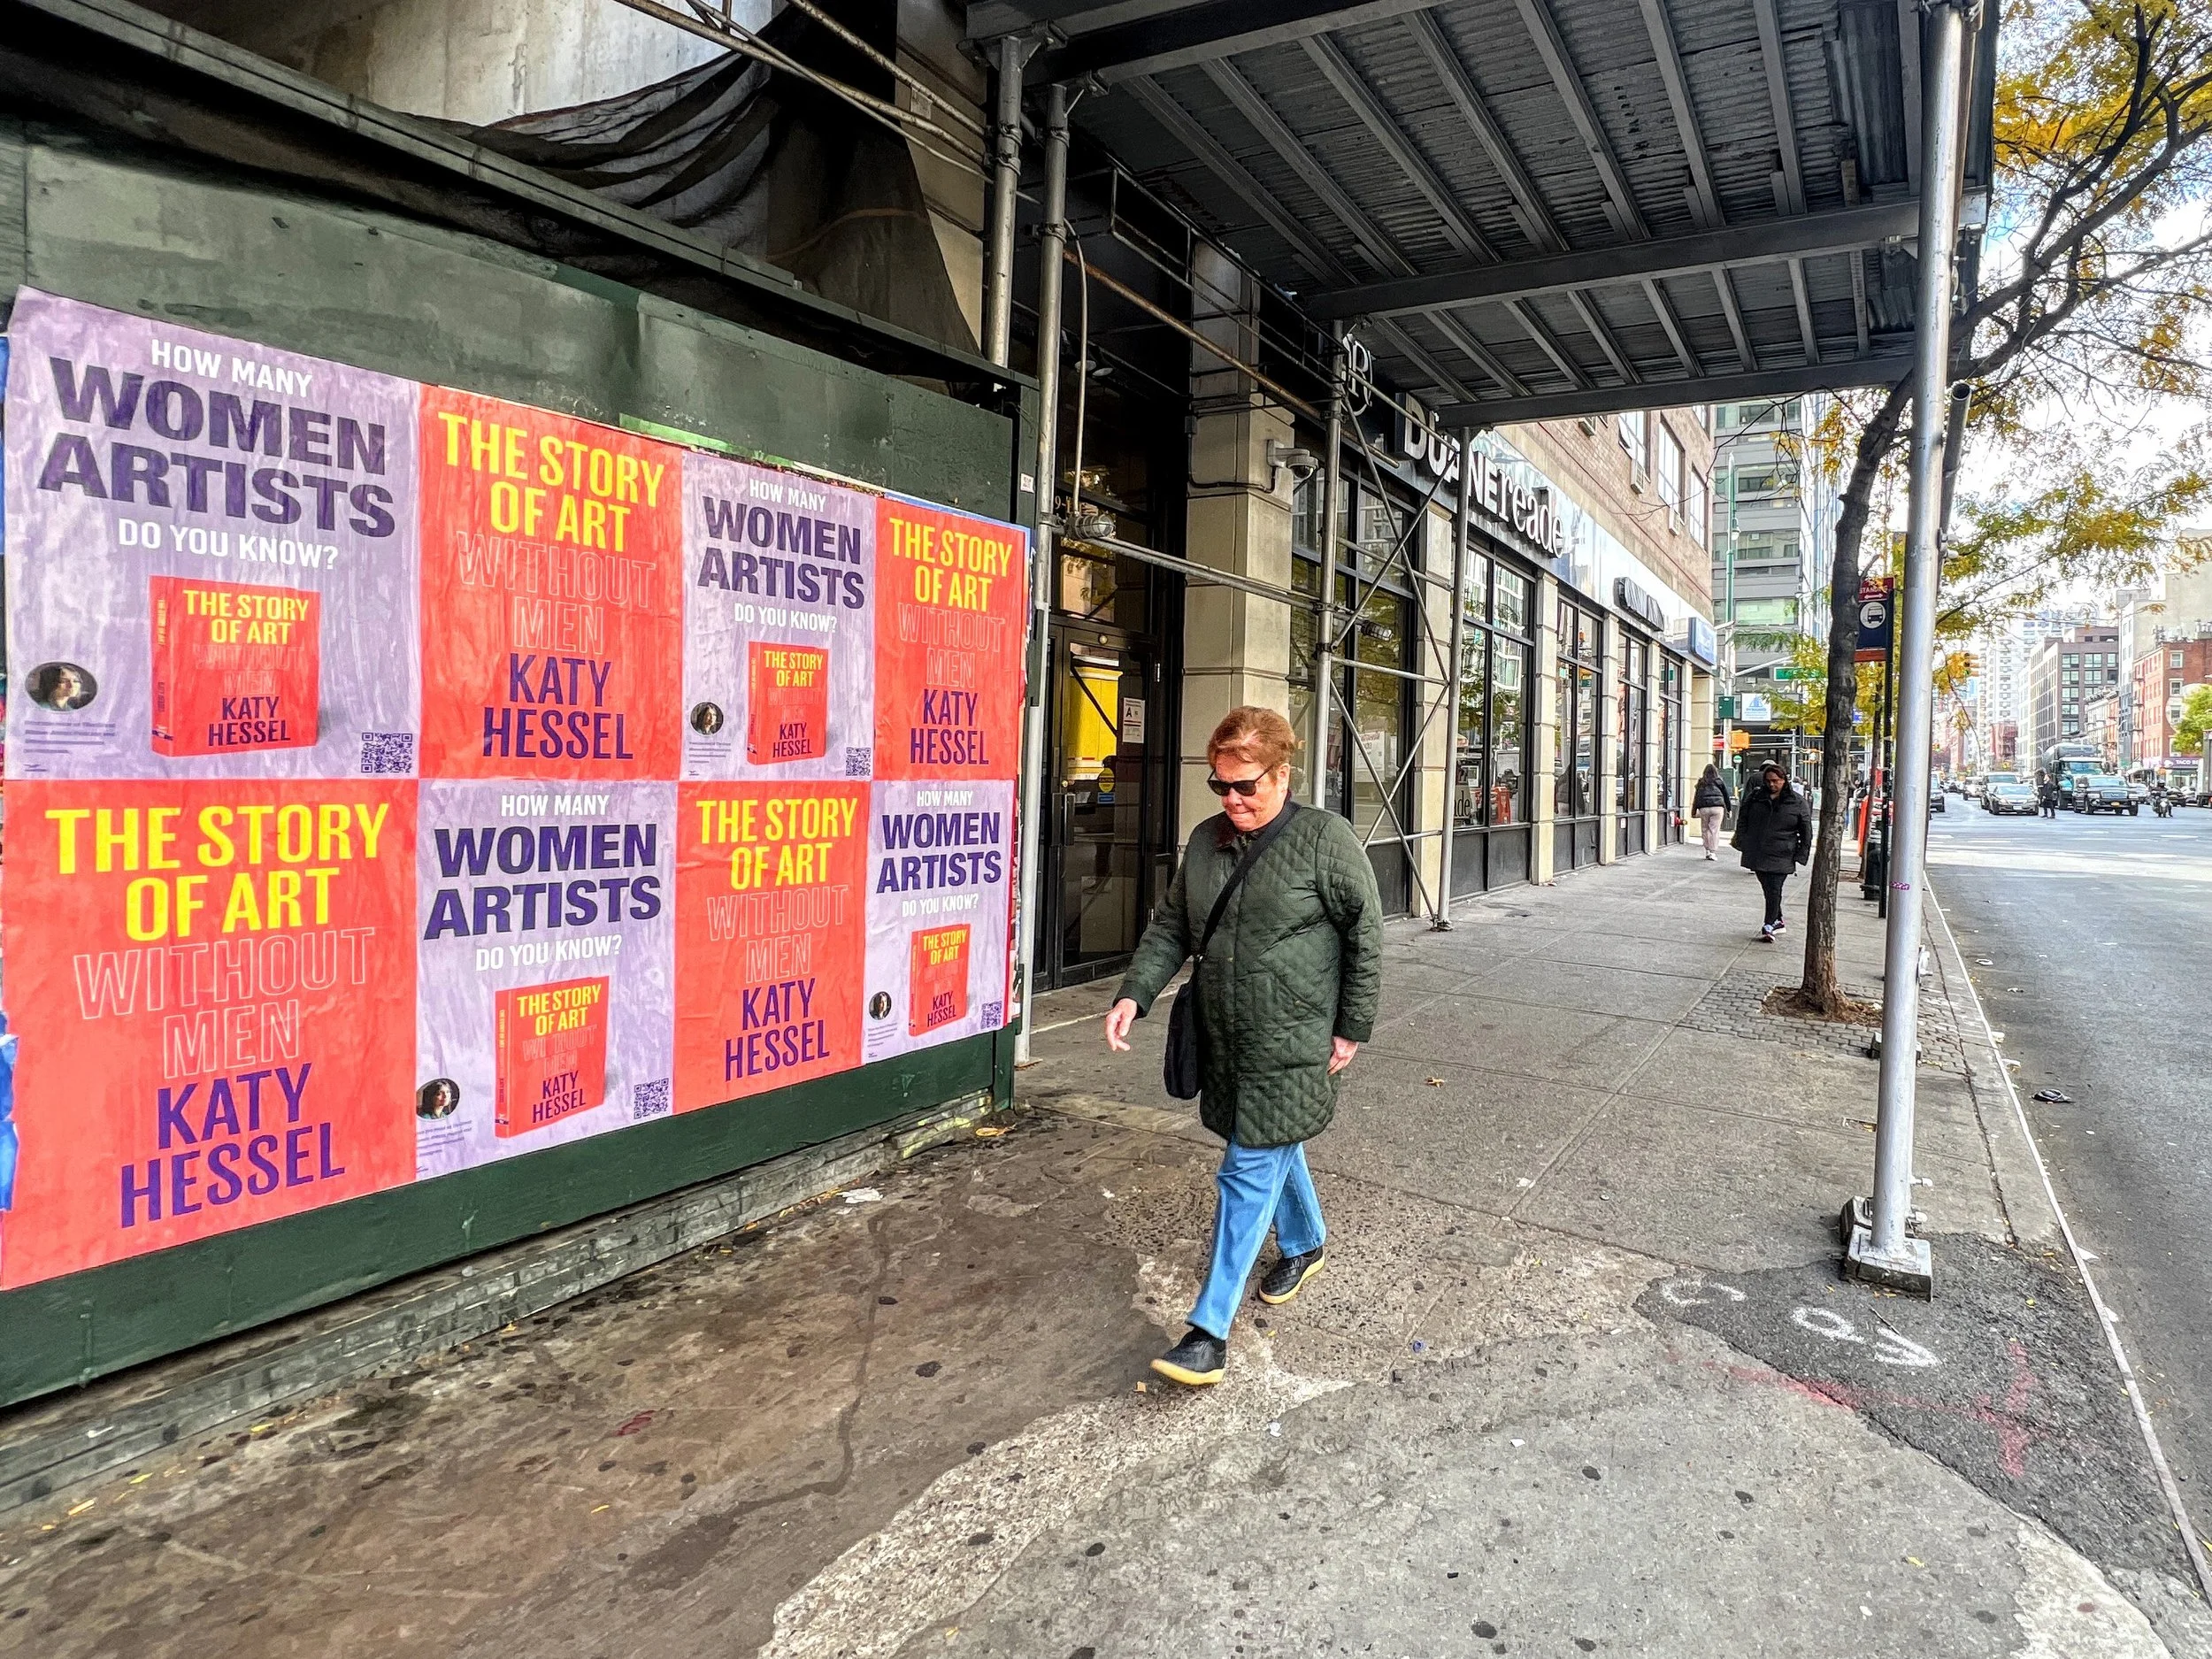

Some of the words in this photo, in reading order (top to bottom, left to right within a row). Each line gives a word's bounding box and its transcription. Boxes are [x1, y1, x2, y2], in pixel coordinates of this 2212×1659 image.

[150, 339, 221, 379] HOW
[231, 361, 312, 398] MANY
[50, 357, 386, 476] WOMEN
[438, 411, 528, 480] THE
[539, 434, 665, 508] STORY
[37, 432, 396, 538] ARTISTS
[749, 479, 783, 503] HOW
[787, 488, 826, 512] MANY
[489, 480, 547, 536] OF
[556, 493, 631, 552] ART
[702, 495, 861, 565] WOMEN
[119, 519, 161, 550] DO
[171, 525, 228, 557] YOU
[239, 535, 339, 570] KNOW?
[889, 518, 935, 564] THE
[940, 530, 1013, 578] STORY
[456, 530, 657, 610] WITHOUT
[697, 546, 865, 610] ARTISTS
[915, 565, 944, 604] OF
[948, 572, 992, 613] ART
[183, 589, 233, 618] THE
[237, 595, 308, 621] STORY
[513, 595, 604, 656] MEN
[734, 603, 754, 624] DO
[758, 606, 787, 628] YOU
[790, 610, 838, 634] KNOW?
[897, 602, 1006, 653] WITHOUT
[211, 618, 242, 643] OF
[247, 621, 292, 645] ART
[509, 652, 612, 707] KATY
[764, 650, 787, 669] THE
[789, 652, 823, 671] STORY
[776, 670, 791, 687] OF
[792, 671, 814, 687] ART
[926, 647, 976, 688] MEN
[222, 696, 280, 720] KATY
[923, 688, 979, 726] KATY
[208, 720, 290, 747] HESSEL
[482, 706, 634, 760] HESSEL
[772, 739, 812, 758] HESSEL
[780, 722, 807, 740] KATY
[910, 727, 990, 765] HESSEL
[501, 795, 549, 818] HOW
[554, 795, 610, 816] MANY
[695, 799, 757, 844] THE
[765, 797, 858, 842] STORY
[916, 791, 941, 807] HOW
[943, 790, 973, 807] MANY
[44, 806, 181, 875] THE
[196, 803, 388, 866] STORY
[434, 823, 657, 878] WOMEN
[882, 811, 1001, 850] WOMEN
[730, 846, 771, 891] OF
[774, 841, 833, 888] ART
[876, 850, 1002, 894] ARTISTS
[125, 874, 209, 941] OF
[221, 867, 340, 933] ART
[423, 875, 662, 941] ARTISTS
[707, 885, 849, 941] WITHOUT
[902, 901, 918, 918] DO
[919, 897, 940, 915] YOU
[941, 893, 979, 912] KNOW?
[475, 947, 504, 972] DO
[509, 941, 549, 966] YOU
[555, 934, 623, 962] KNOW?
[745, 932, 812, 984] MEN
[923, 933, 940, 951] THE
[941, 929, 967, 948] STORY
[930, 949, 942, 965] OF
[942, 945, 960, 962] ART
[73, 926, 376, 1021] WITHOUT
[517, 993, 550, 1018] THE
[552, 984, 602, 1011] STORY
[535, 1013, 555, 1036] OF
[557, 1007, 588, 1032] ART
[741, 977, 816, 1031] KATY
[927, 1004, 956, 1027] HESSEL
[933, 991, 953, 1010] KATY
[163, 999, 300, 1080] MEN
[725, 1019, 830, 1082] HESSEL
[157, 1063, 312, 1150] KATY
[533, 1088, 586, 1123] HESSEL
[542, 1071, 579, 1099] KATY
[120, 1122, 346, 1229] HESSEL
